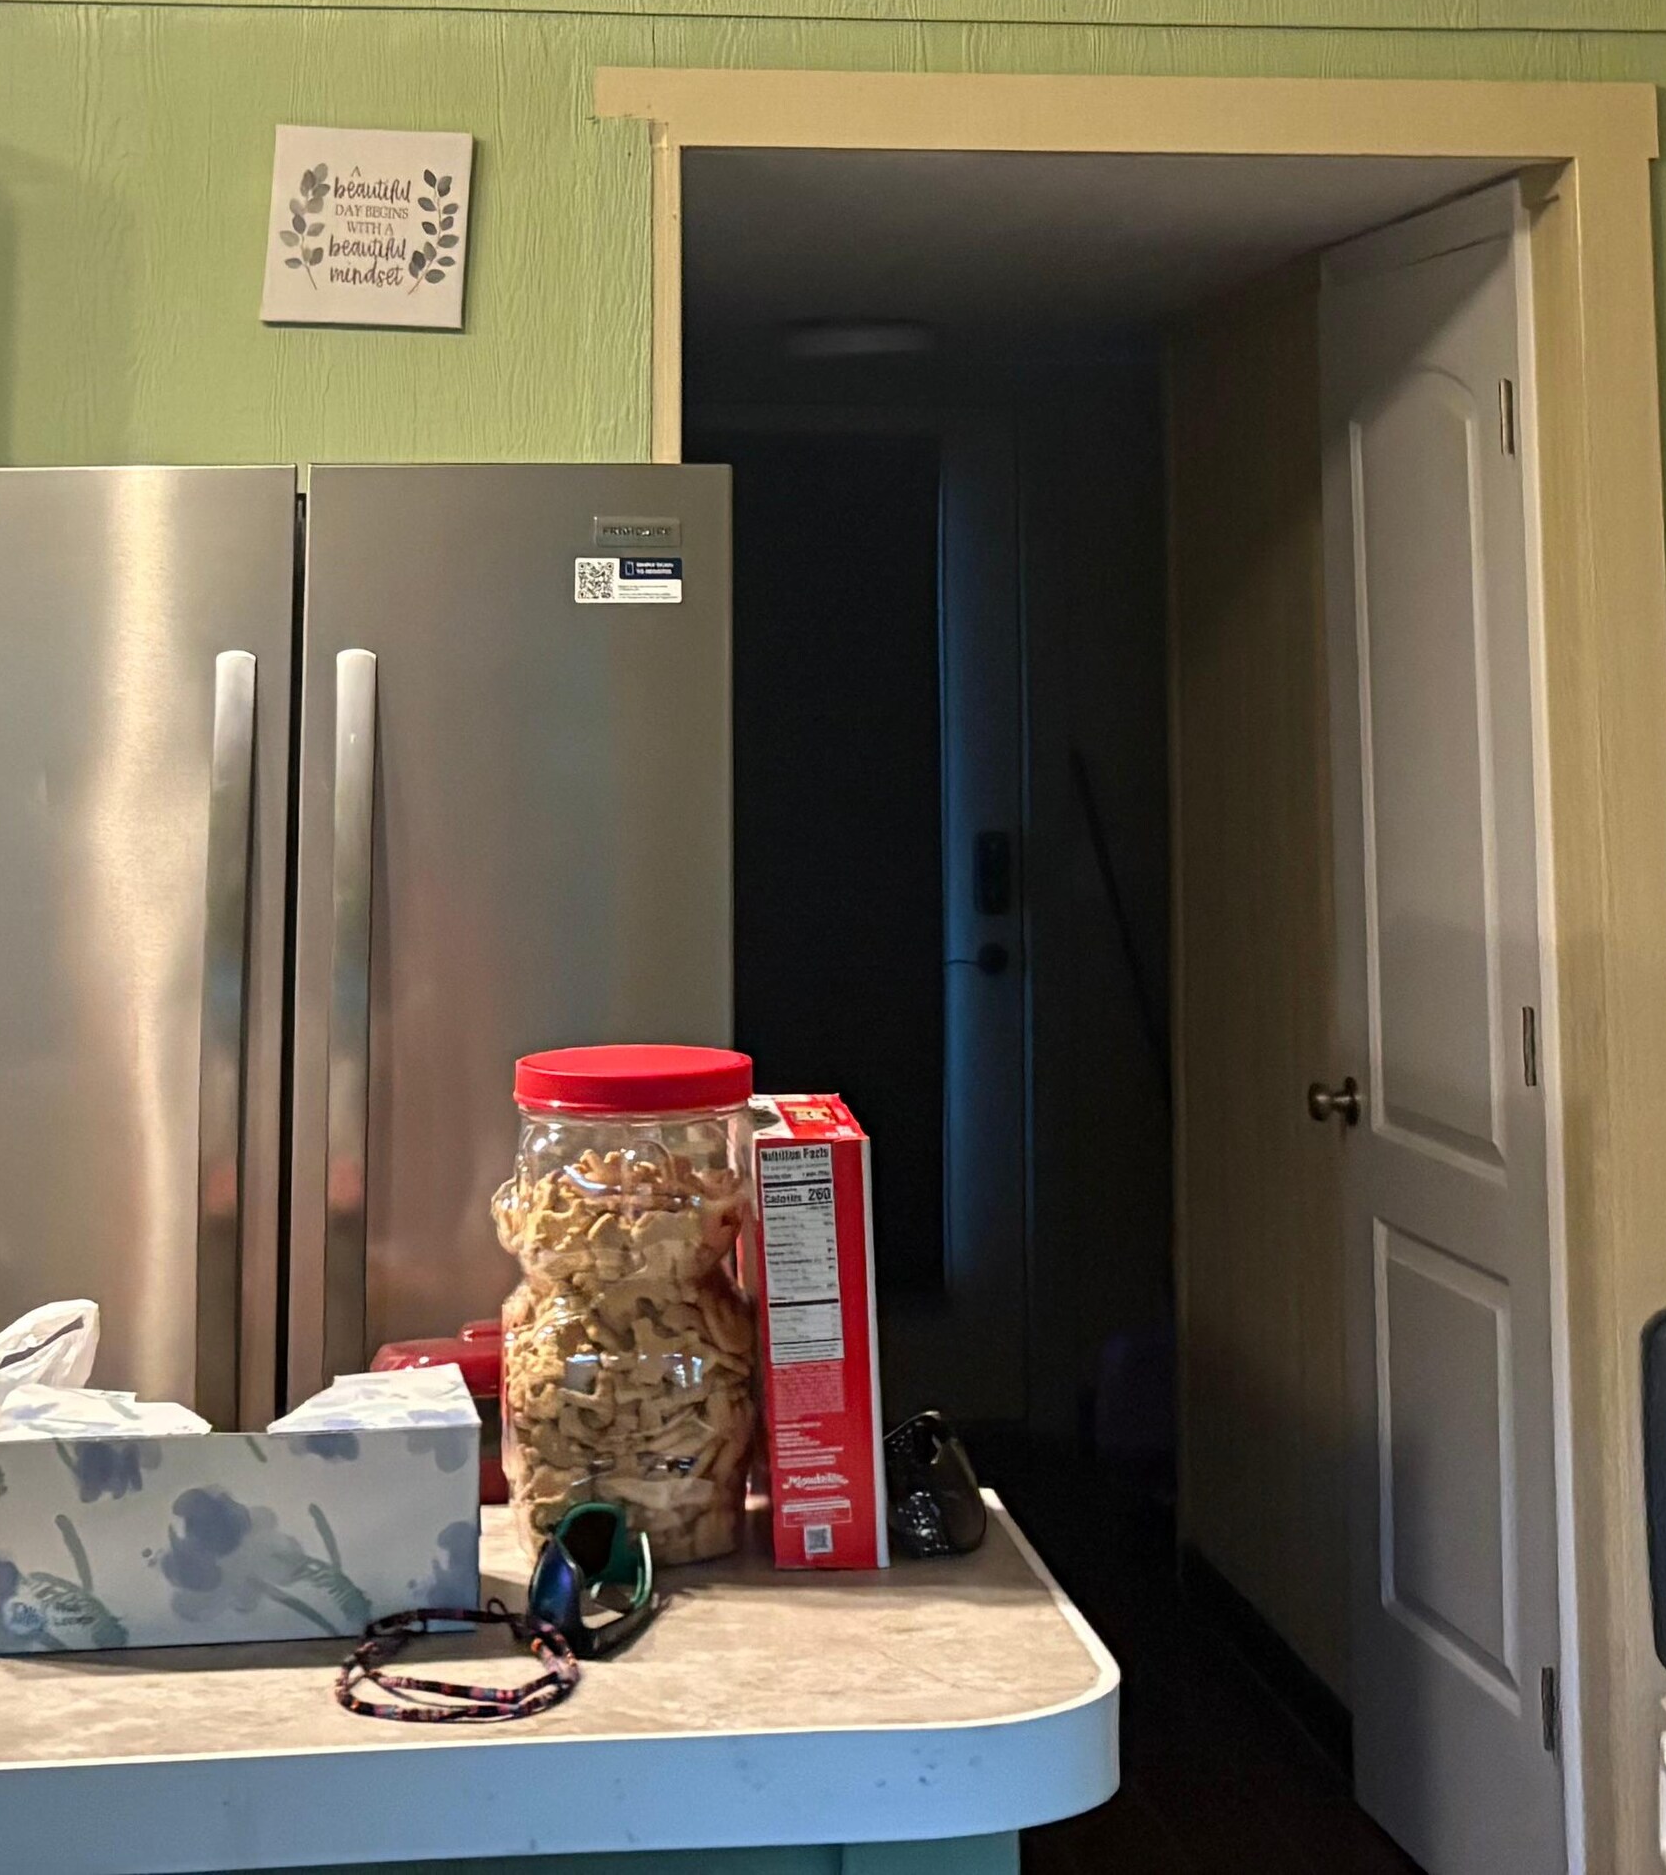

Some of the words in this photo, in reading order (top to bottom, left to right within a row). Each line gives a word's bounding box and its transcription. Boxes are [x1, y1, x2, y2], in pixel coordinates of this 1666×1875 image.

[334, 176, 411, 204] beautiful
[335, 204, 363, 218] DAY
[365, 204, 409, 220] BEGINS
[347, 220, 382, 235] WITH
[384, 222, 394, 236] A
[329, 234, 406, 261] beautiful
[330, 256, 404, 287] mindset
[803, 1146, 830, 1160] Facts
